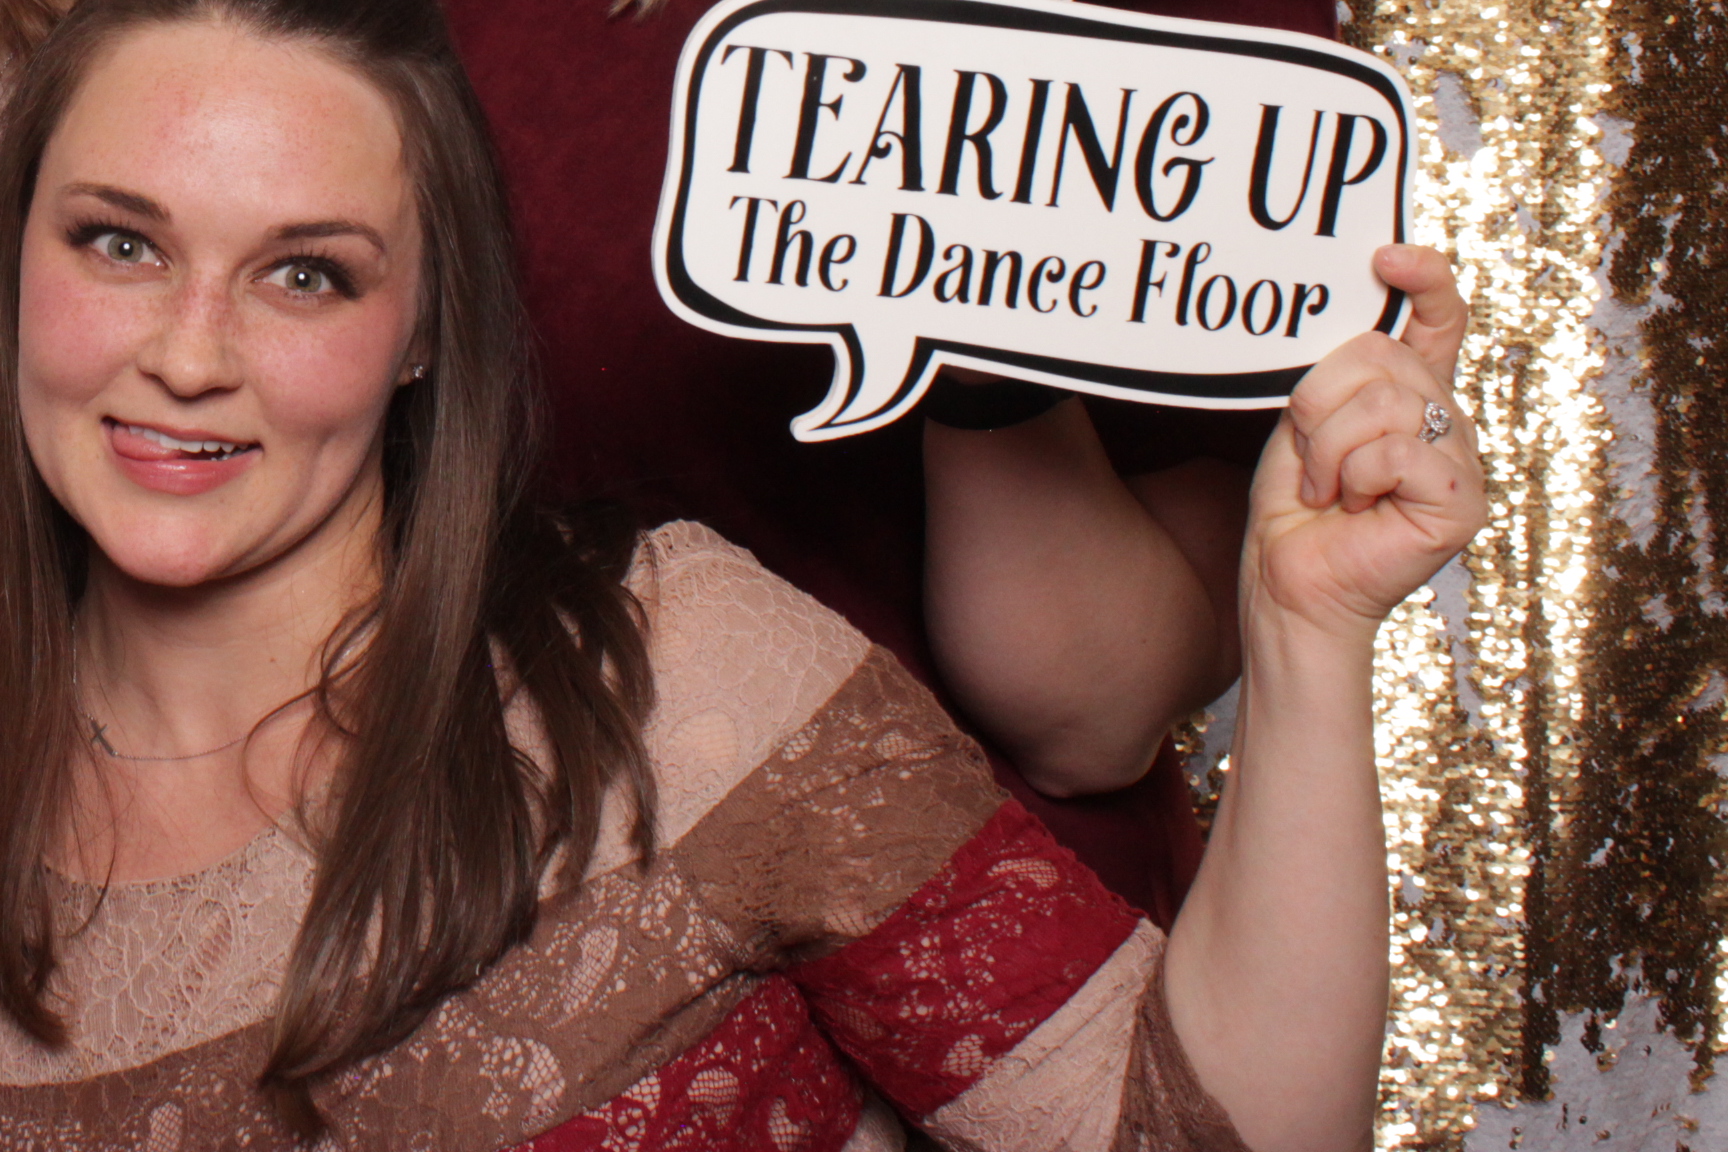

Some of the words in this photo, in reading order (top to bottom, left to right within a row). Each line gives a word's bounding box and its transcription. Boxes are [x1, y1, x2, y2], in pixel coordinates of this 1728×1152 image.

[720, 43, 1216, 222] TEARING
[1247, 101, 1389, 240] UP
[728, 194, 857, 293] The
[875, 211, 1107, 318] Dance
[1126, 237, 1331, 341] Floor
